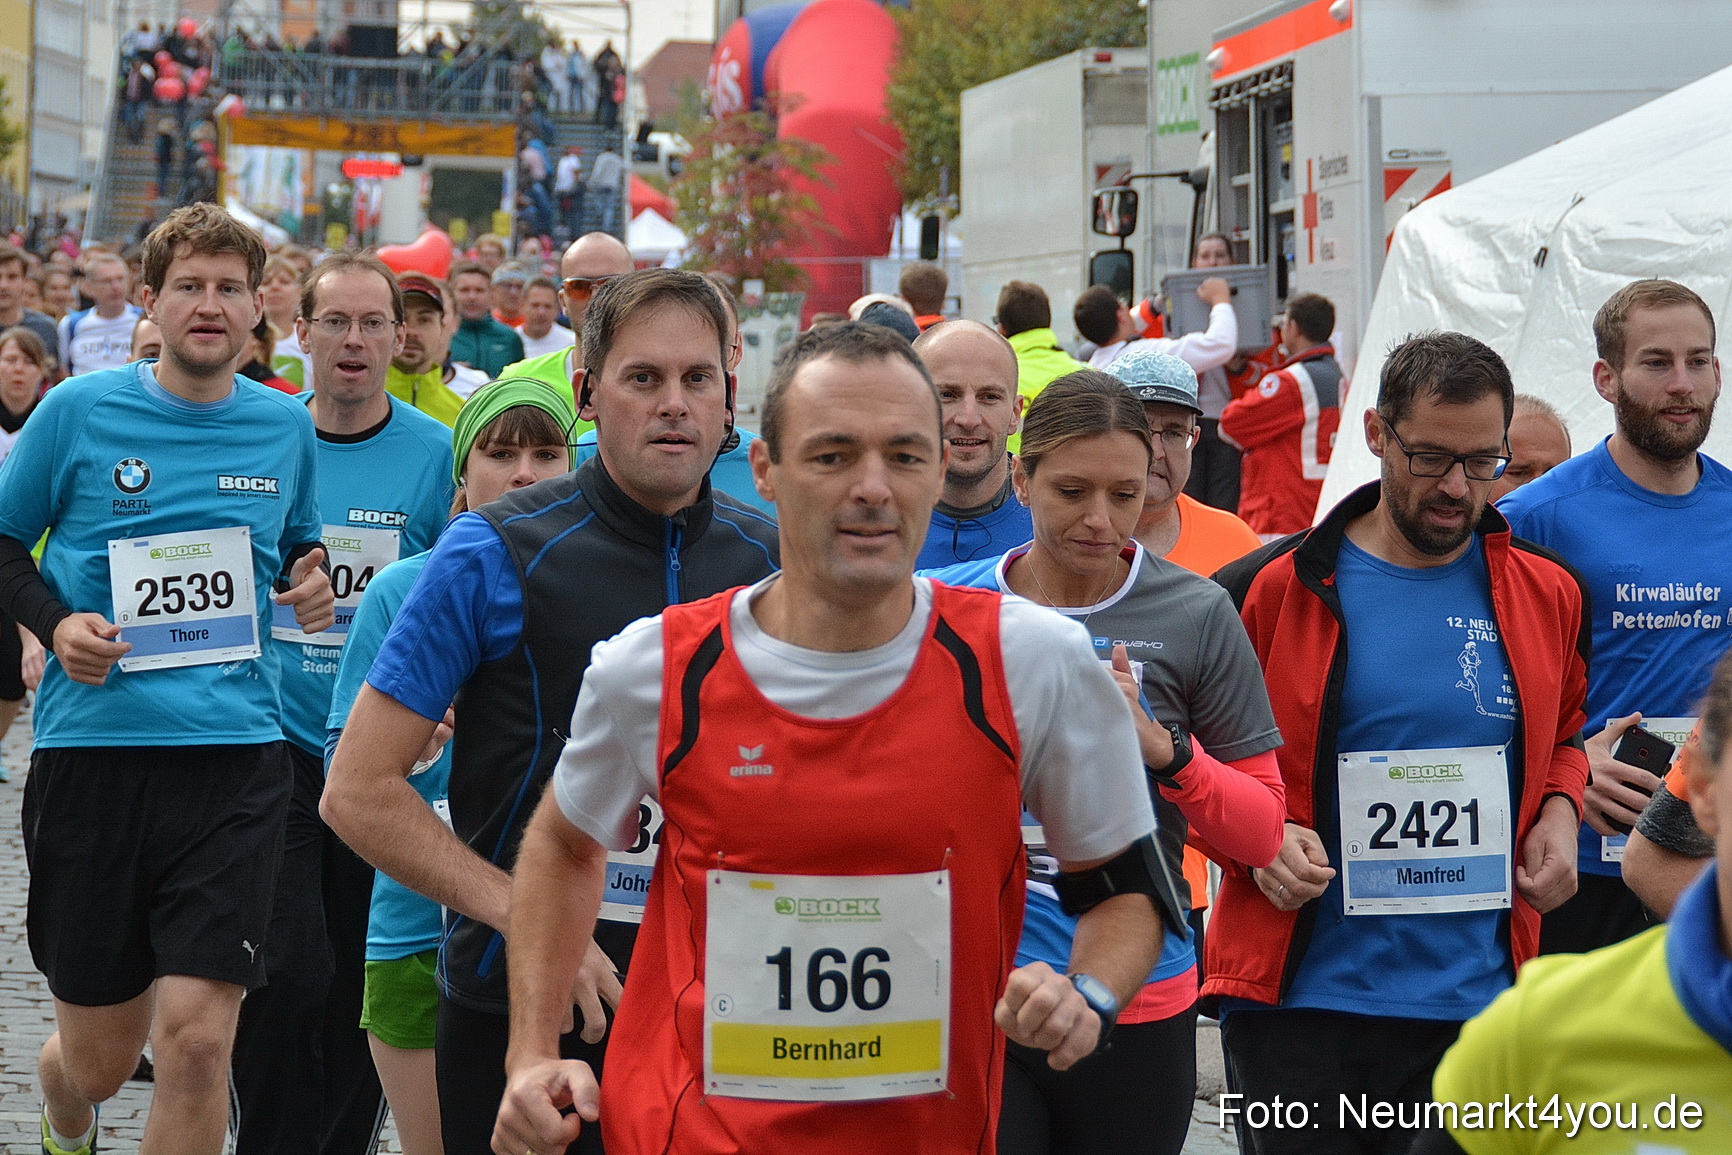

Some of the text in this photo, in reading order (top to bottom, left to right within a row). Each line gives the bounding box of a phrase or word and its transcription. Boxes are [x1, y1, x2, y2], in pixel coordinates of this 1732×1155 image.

[1156, 53, 1200, 133] BOCK
[117, 459, 148, 471] BMW
[217, 475, 280, 493] BOCK
[113, 500, 151, 509] PARTL
[347, 508, 408, 526] BOCK
[164, 543, 212, 558] BOCK
[134, 570, 234, 617] 2539
[1616, 582, 1721, 602] Kirwaläufer
[1446, 617, 1497, 631] 12. NEU
[1612, 609, 1722, 629] Pettenhofen
[170, 629, 209, 642] Thore
[1467, 629, 1498, 642] STAD
[302, 660, 338, 674] Stadt
[730, 764, 773, 776] erima
[1406, 764, 1463, 778] BOCK
[1368, 798, 1479, 849] 2421
[1351, 845, 1358, 853] D
[1397, 866, 1465, 884] Manfred
[797, 898, 881, 916] BOCK
[766, 946, 891, 1013] 166
[718, 999, 727, 1011] C
[772, 1035, 881, 1060] Bernhard
